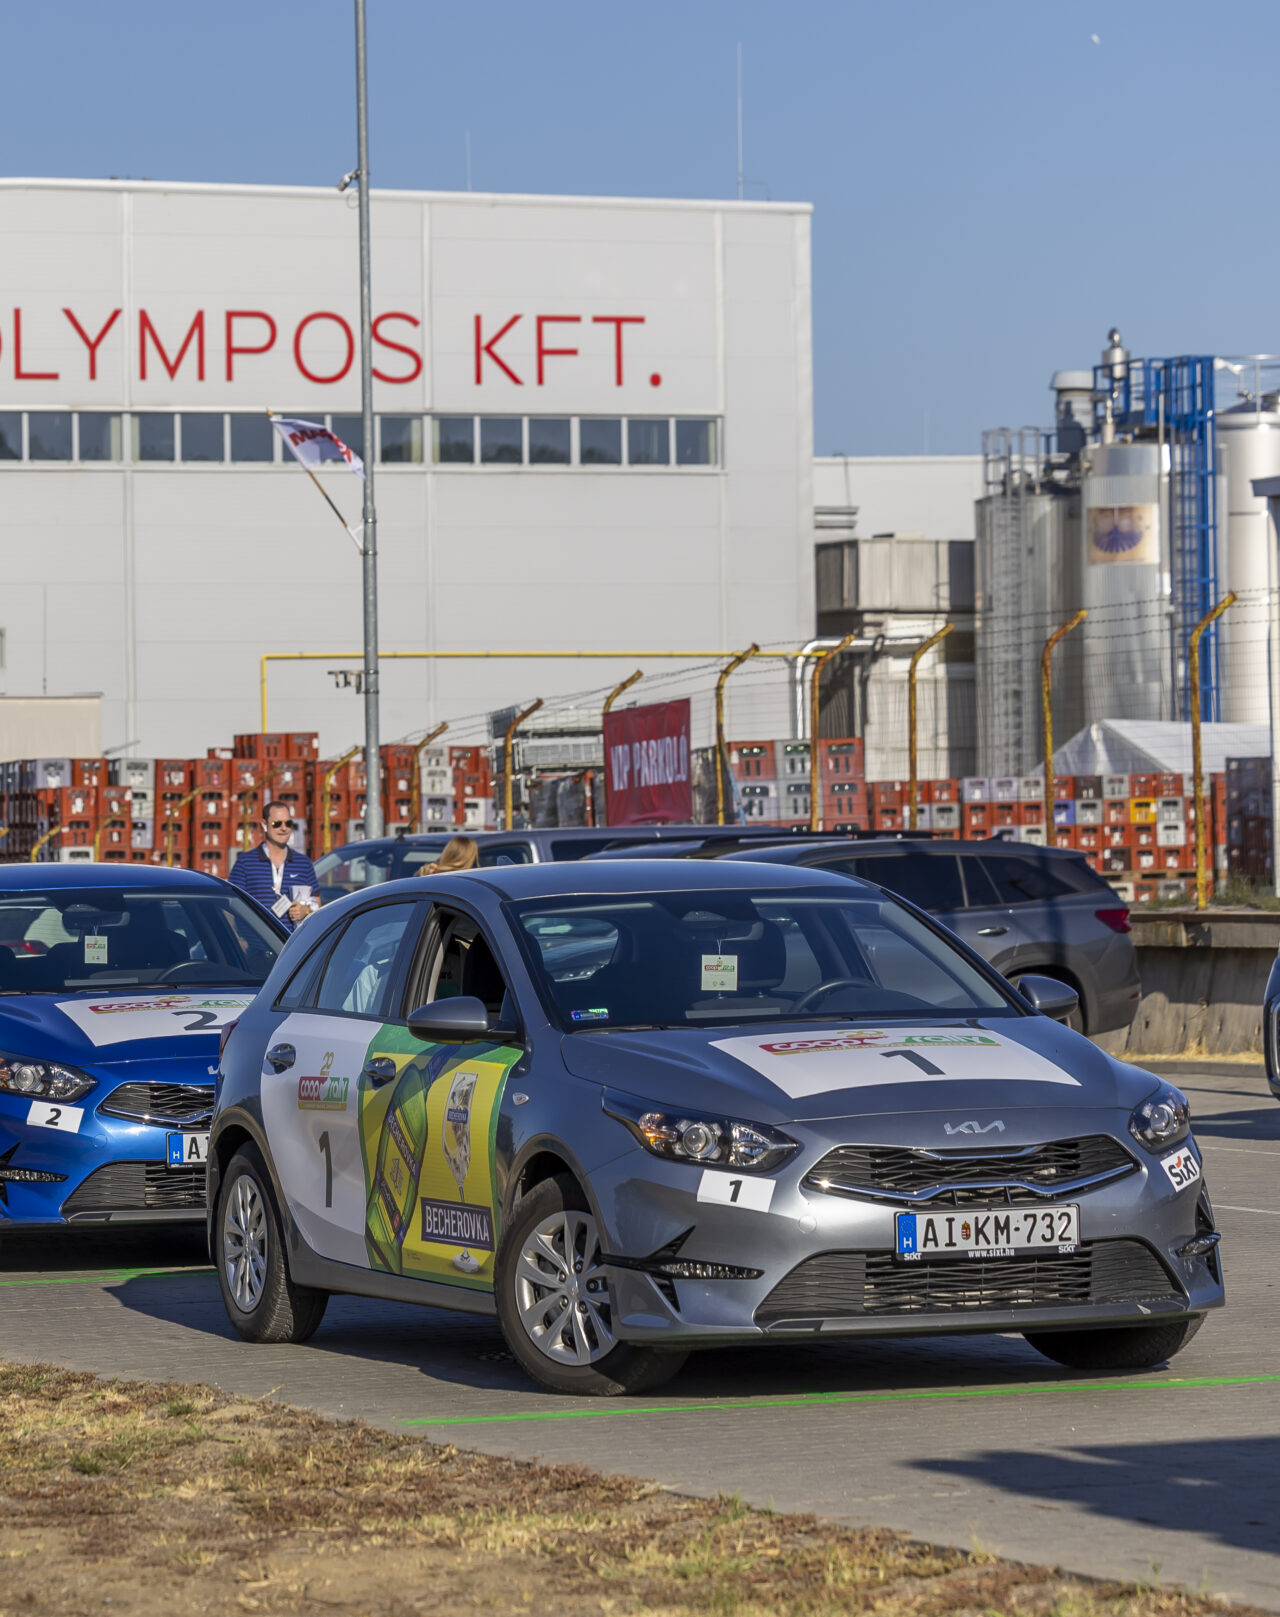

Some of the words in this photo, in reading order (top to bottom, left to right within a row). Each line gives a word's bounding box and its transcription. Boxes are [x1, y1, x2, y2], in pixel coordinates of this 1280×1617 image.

[474, 313, 663, 387] KFT.
[610, 743, 630, 791] VIP
[98, 1002, 167, 1011] coop
[171, 1010, 224, 1031] 2
[772, 1038, 861, 1050] coop
[911, 1035, 985, 1044] rally
[879, 1049, 946, 1075] 1
[300, 1080, 320, 1102] coop
[45, 1107, 62, 1126] 2
[172, 1150, 180, 1159] H
[319, 1130, 333, 1208] 1
[729, 1179, 743, 1203] 1
[425, 1205, 490, 1242] BECHEROVKA
[903, 1237, 912, 1248] H
[968, 1248, 1015, 1258] www.sixt.hu
